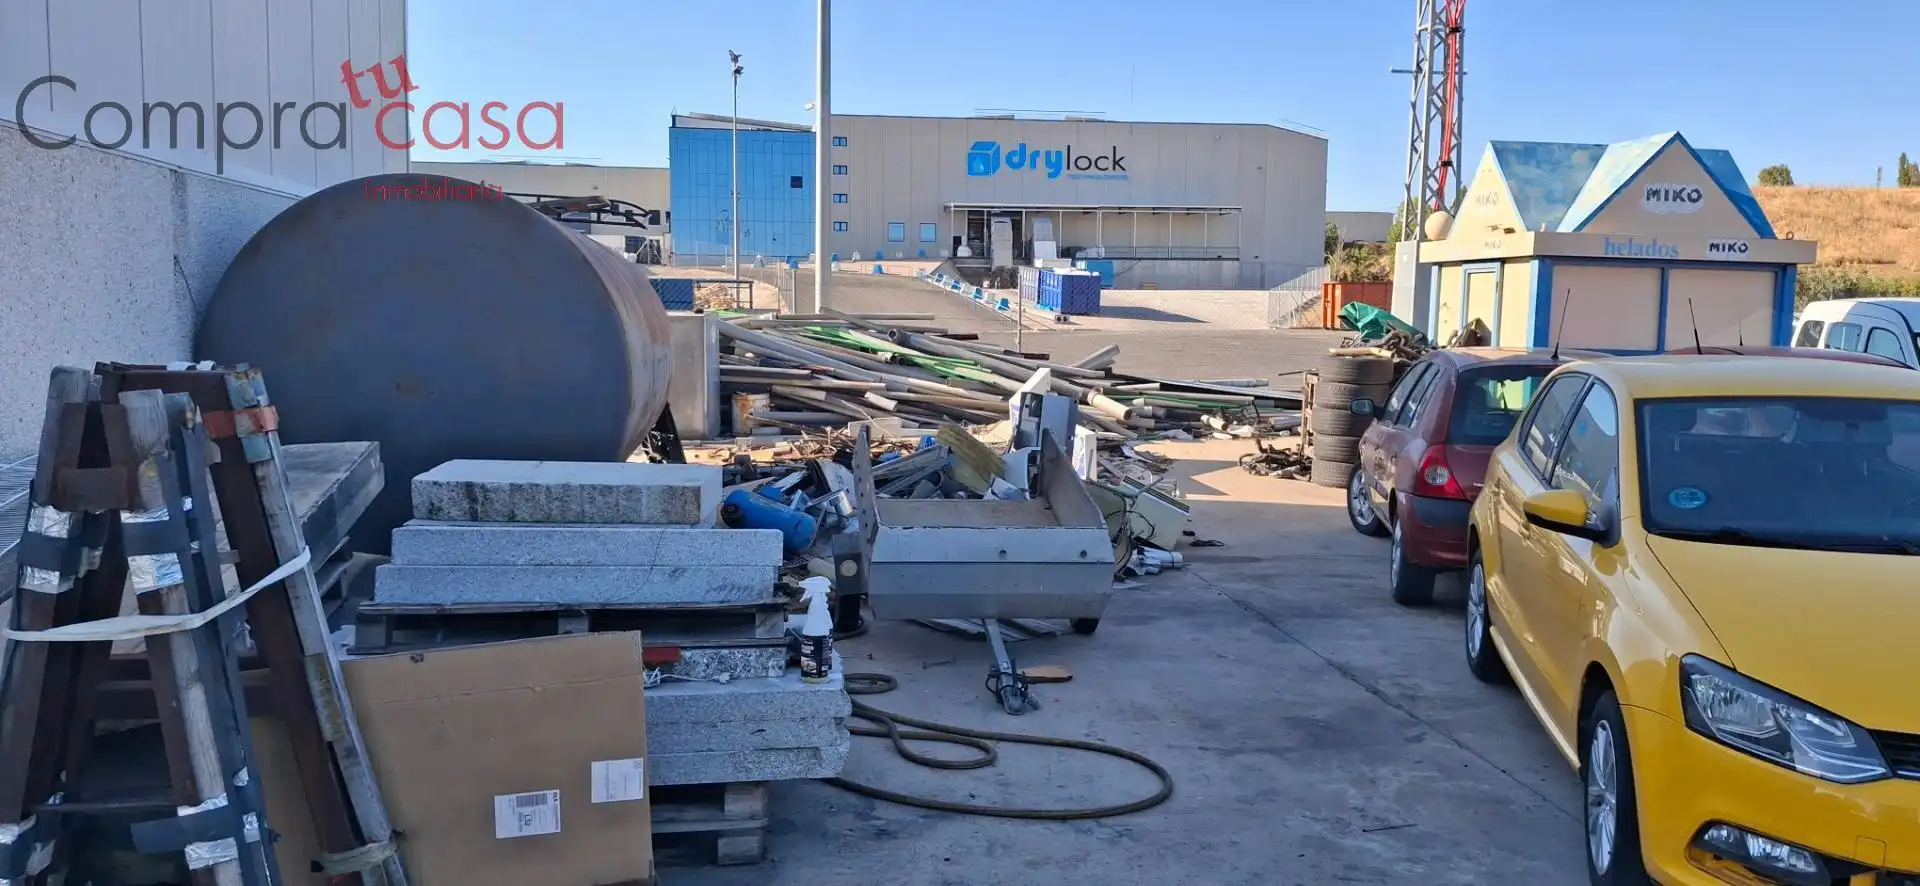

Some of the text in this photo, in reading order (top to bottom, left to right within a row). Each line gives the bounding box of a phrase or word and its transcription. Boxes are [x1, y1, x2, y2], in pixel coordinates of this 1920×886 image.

[1004, 142, 1126, 178] drylock
[1646, 187, 1703, 204] MIKO
[1604, 237, 1679, 258] helados
[1709, 242, 1749, 253] MIKO
